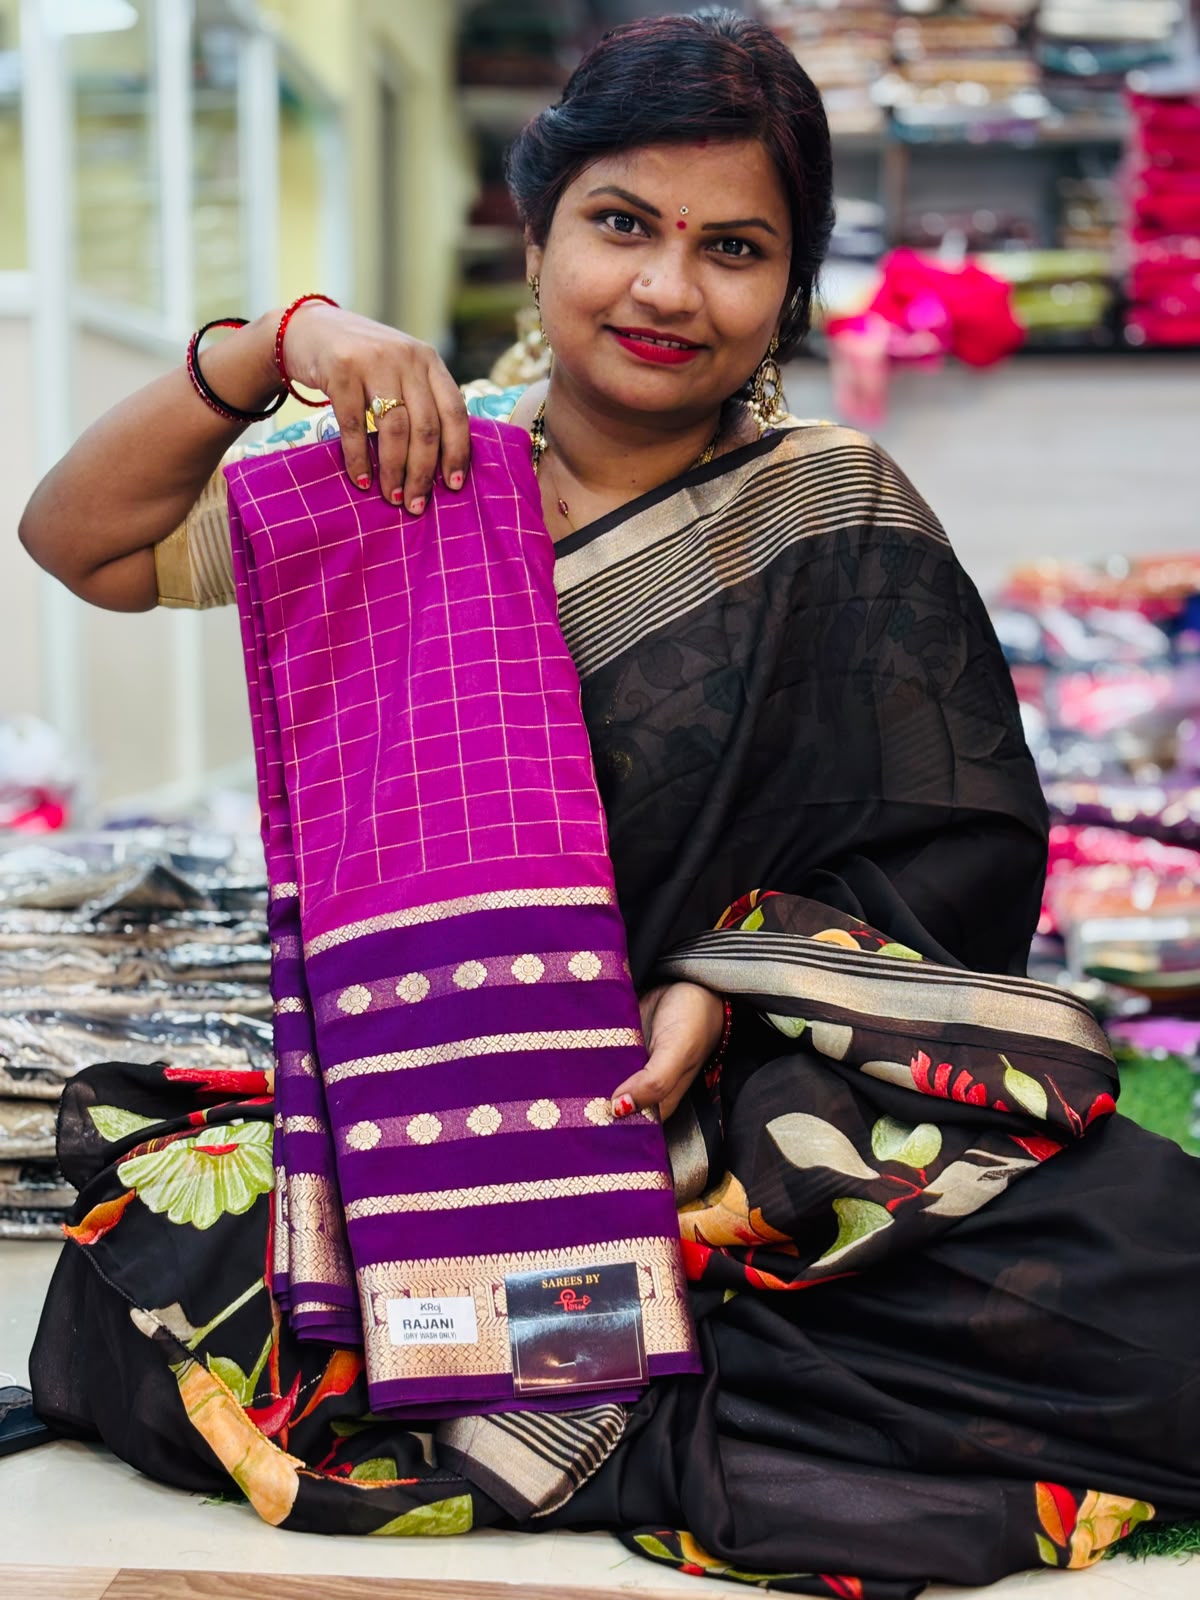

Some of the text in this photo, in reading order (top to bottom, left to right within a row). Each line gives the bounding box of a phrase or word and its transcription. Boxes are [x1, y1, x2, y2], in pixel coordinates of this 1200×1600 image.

[541, 1273, 600, 1289] SAREES BY
[403, 1318, 454, 1330] RAJANI
[403, 1332, 418, 1340] (DRY
[439, 1331, 457, 1340] ONLY)
